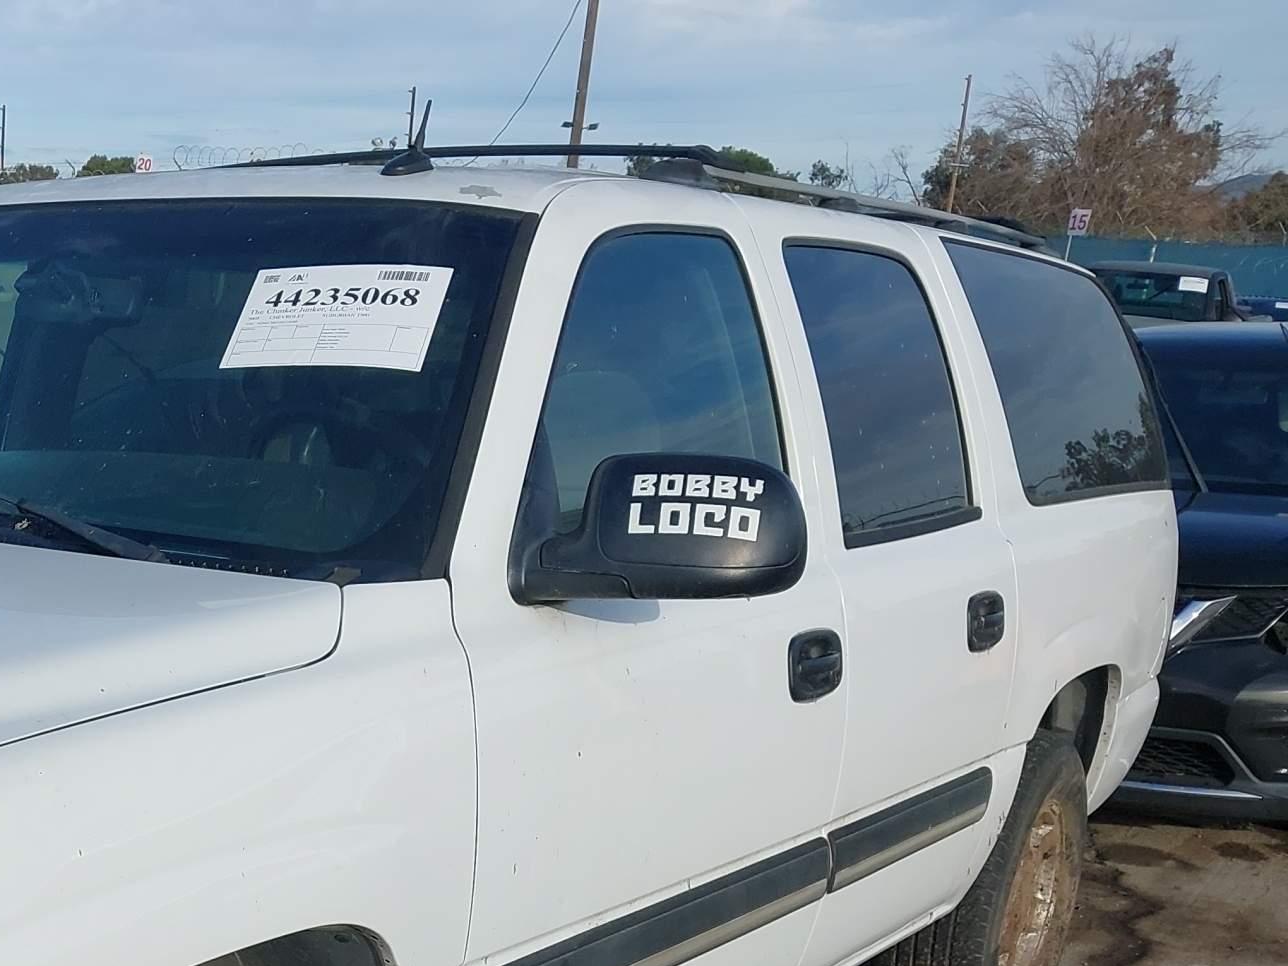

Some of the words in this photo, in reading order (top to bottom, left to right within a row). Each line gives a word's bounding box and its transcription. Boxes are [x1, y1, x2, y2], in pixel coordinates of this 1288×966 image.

[137, 158, 152, 171] 20
[1069, 213, 1089, 231] 15
[265, 287, 421, 307] 44235068
[631, 473, 765, 502] BOBBY
[628, 502, 761, 542] LOCO
